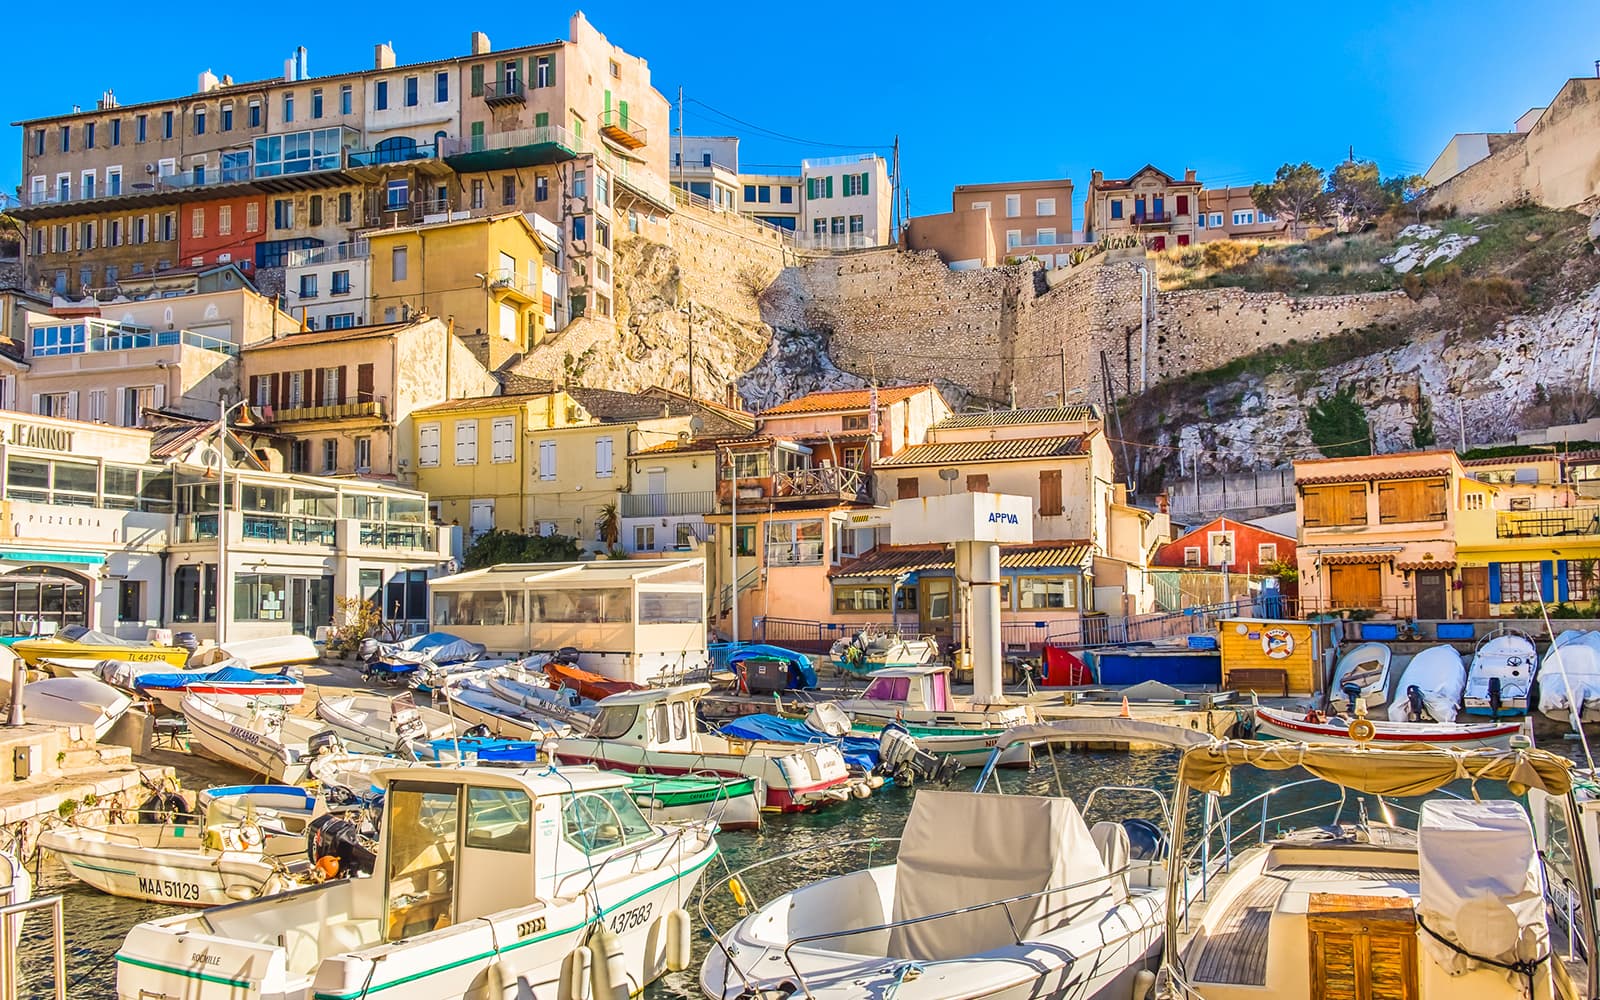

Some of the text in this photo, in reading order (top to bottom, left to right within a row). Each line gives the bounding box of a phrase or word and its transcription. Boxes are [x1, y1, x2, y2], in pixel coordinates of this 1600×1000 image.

[7, 423, 75, 452] JEANNOT
[29, 514, 101, 527] PIZZERIA
[988, 512, 1018, 524] APPVA
[138, 876, 200, 901] MAA 51129
